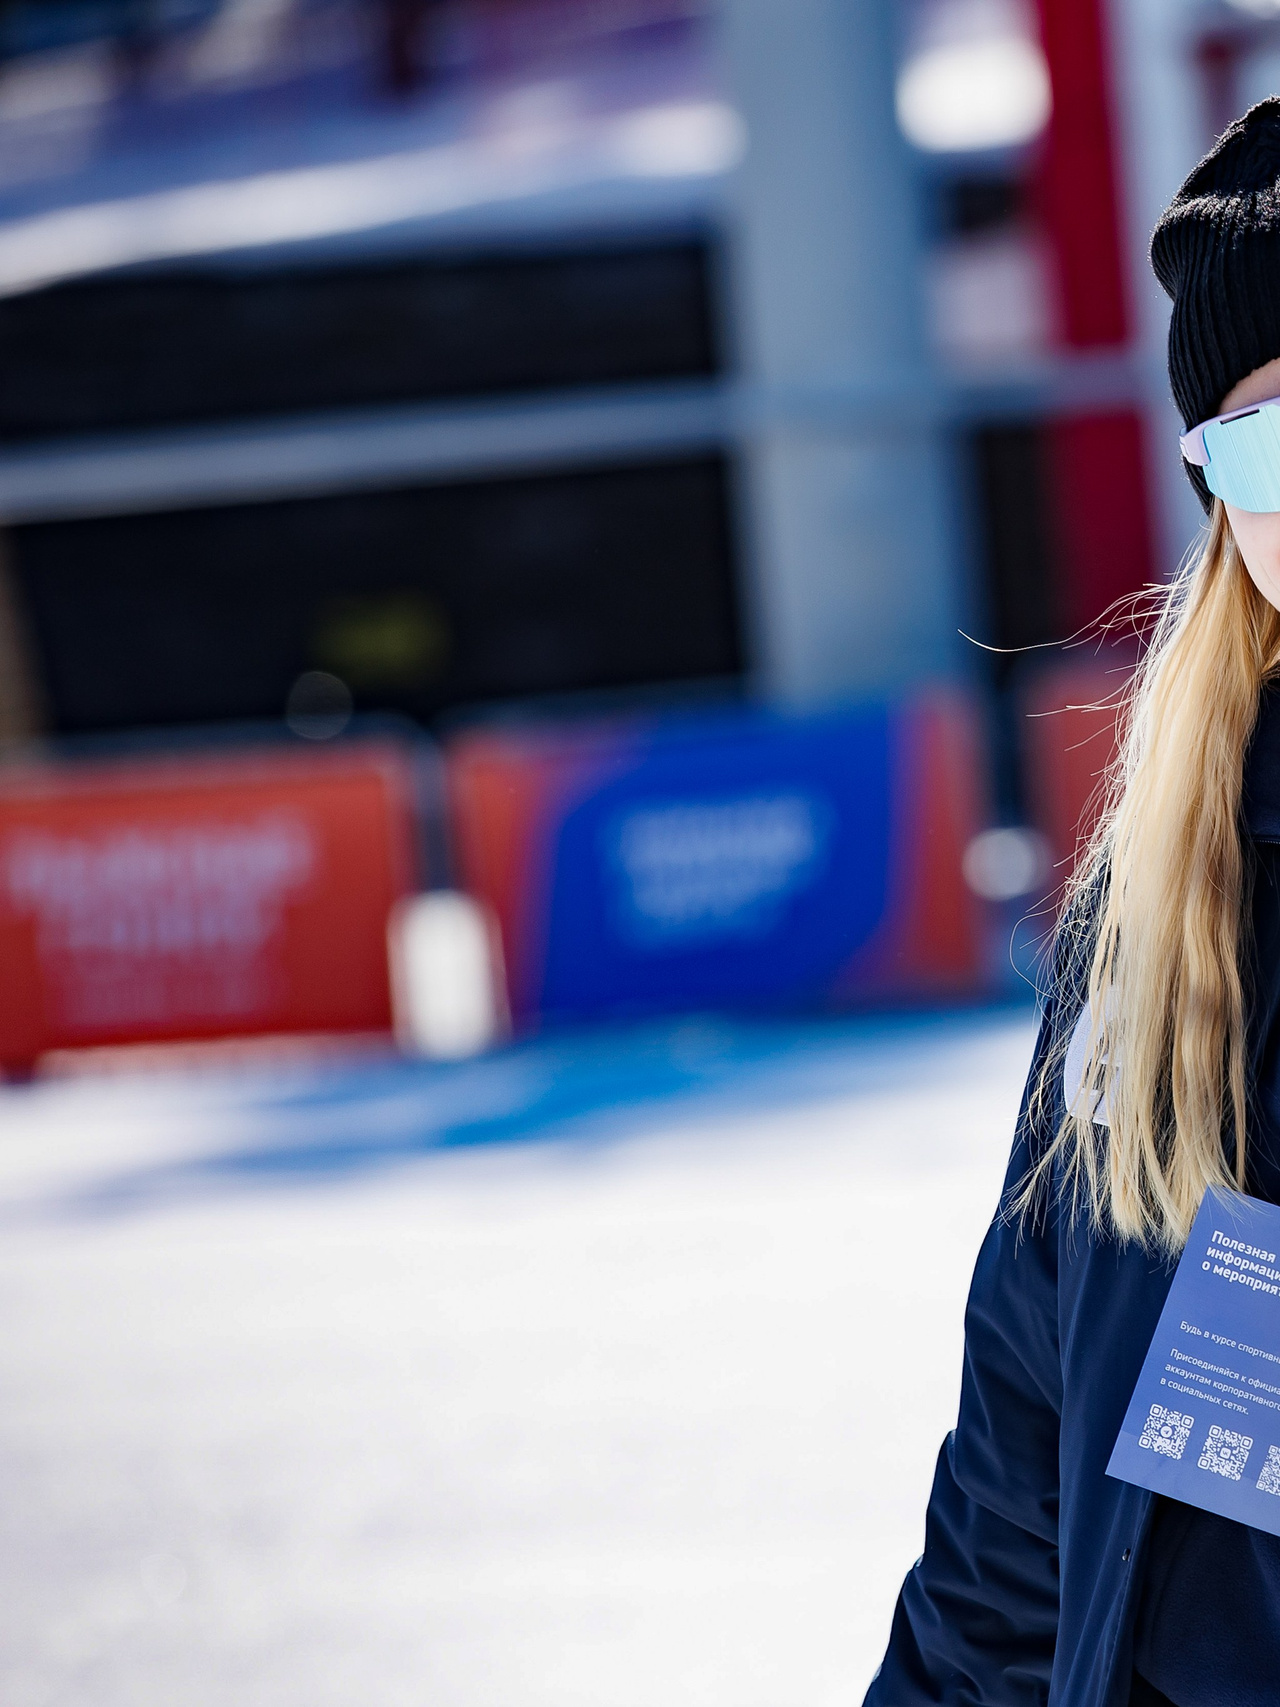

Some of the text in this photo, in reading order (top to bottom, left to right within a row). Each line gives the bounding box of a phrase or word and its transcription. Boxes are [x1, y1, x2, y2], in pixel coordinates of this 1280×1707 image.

[1211, 1230, 1276, 1263] Полезная
[1201, 1261, 1211, 1271] о
[1180, 1320, 1202, 1336] Будь
[1203, 1330, 1210, 1338] в
[1211, 1333, 1237, 1348] курсе
[1164, 1363, 1212, 1386] аккаунтам
[1170, 1348, 1240, 1380] Присоединяйся
[1240, 1375, 1247, 1383] к
[1160, 1377, 1249, 1415] в социальных сетях.
